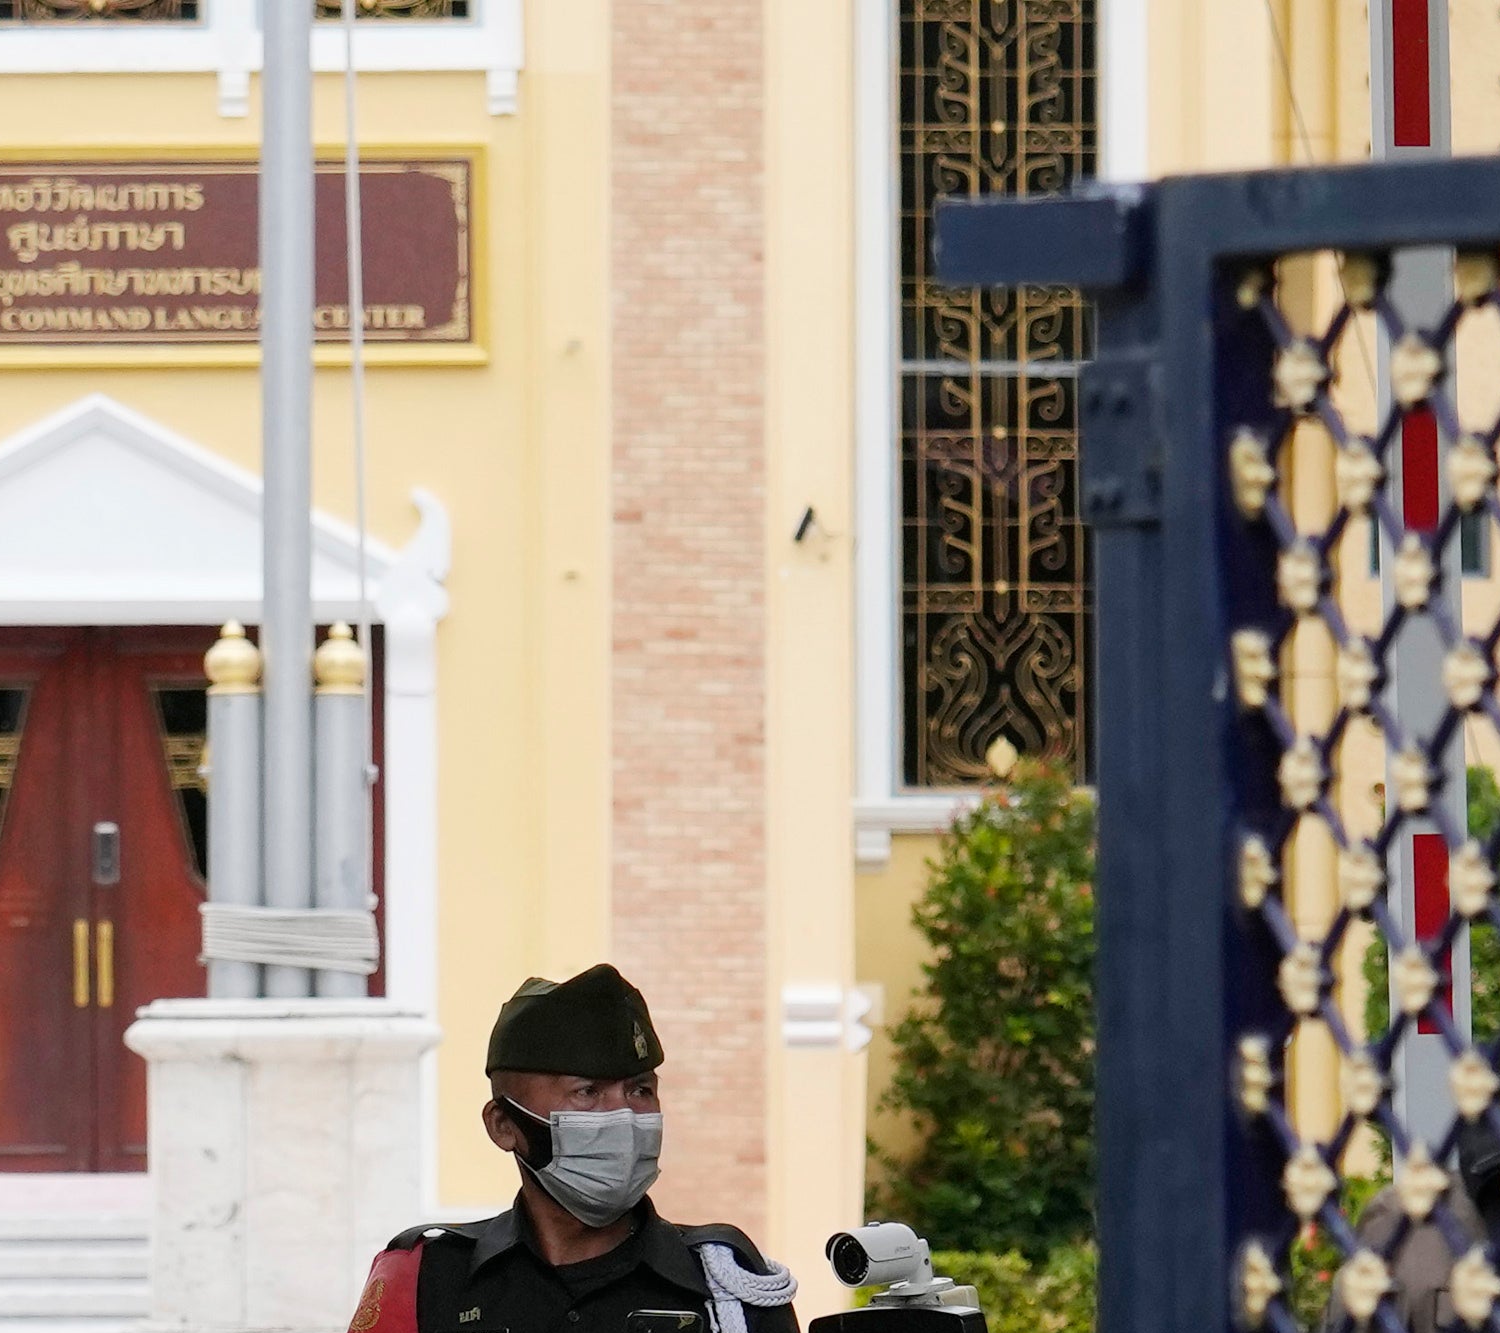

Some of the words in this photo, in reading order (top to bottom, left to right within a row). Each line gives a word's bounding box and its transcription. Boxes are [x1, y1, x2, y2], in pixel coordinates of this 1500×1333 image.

[6, 214, 186, 263] ศูนย์ภาษา
[0, 306, 152, 332] COMMAND
[154, 305, 263, 331] LANGU
